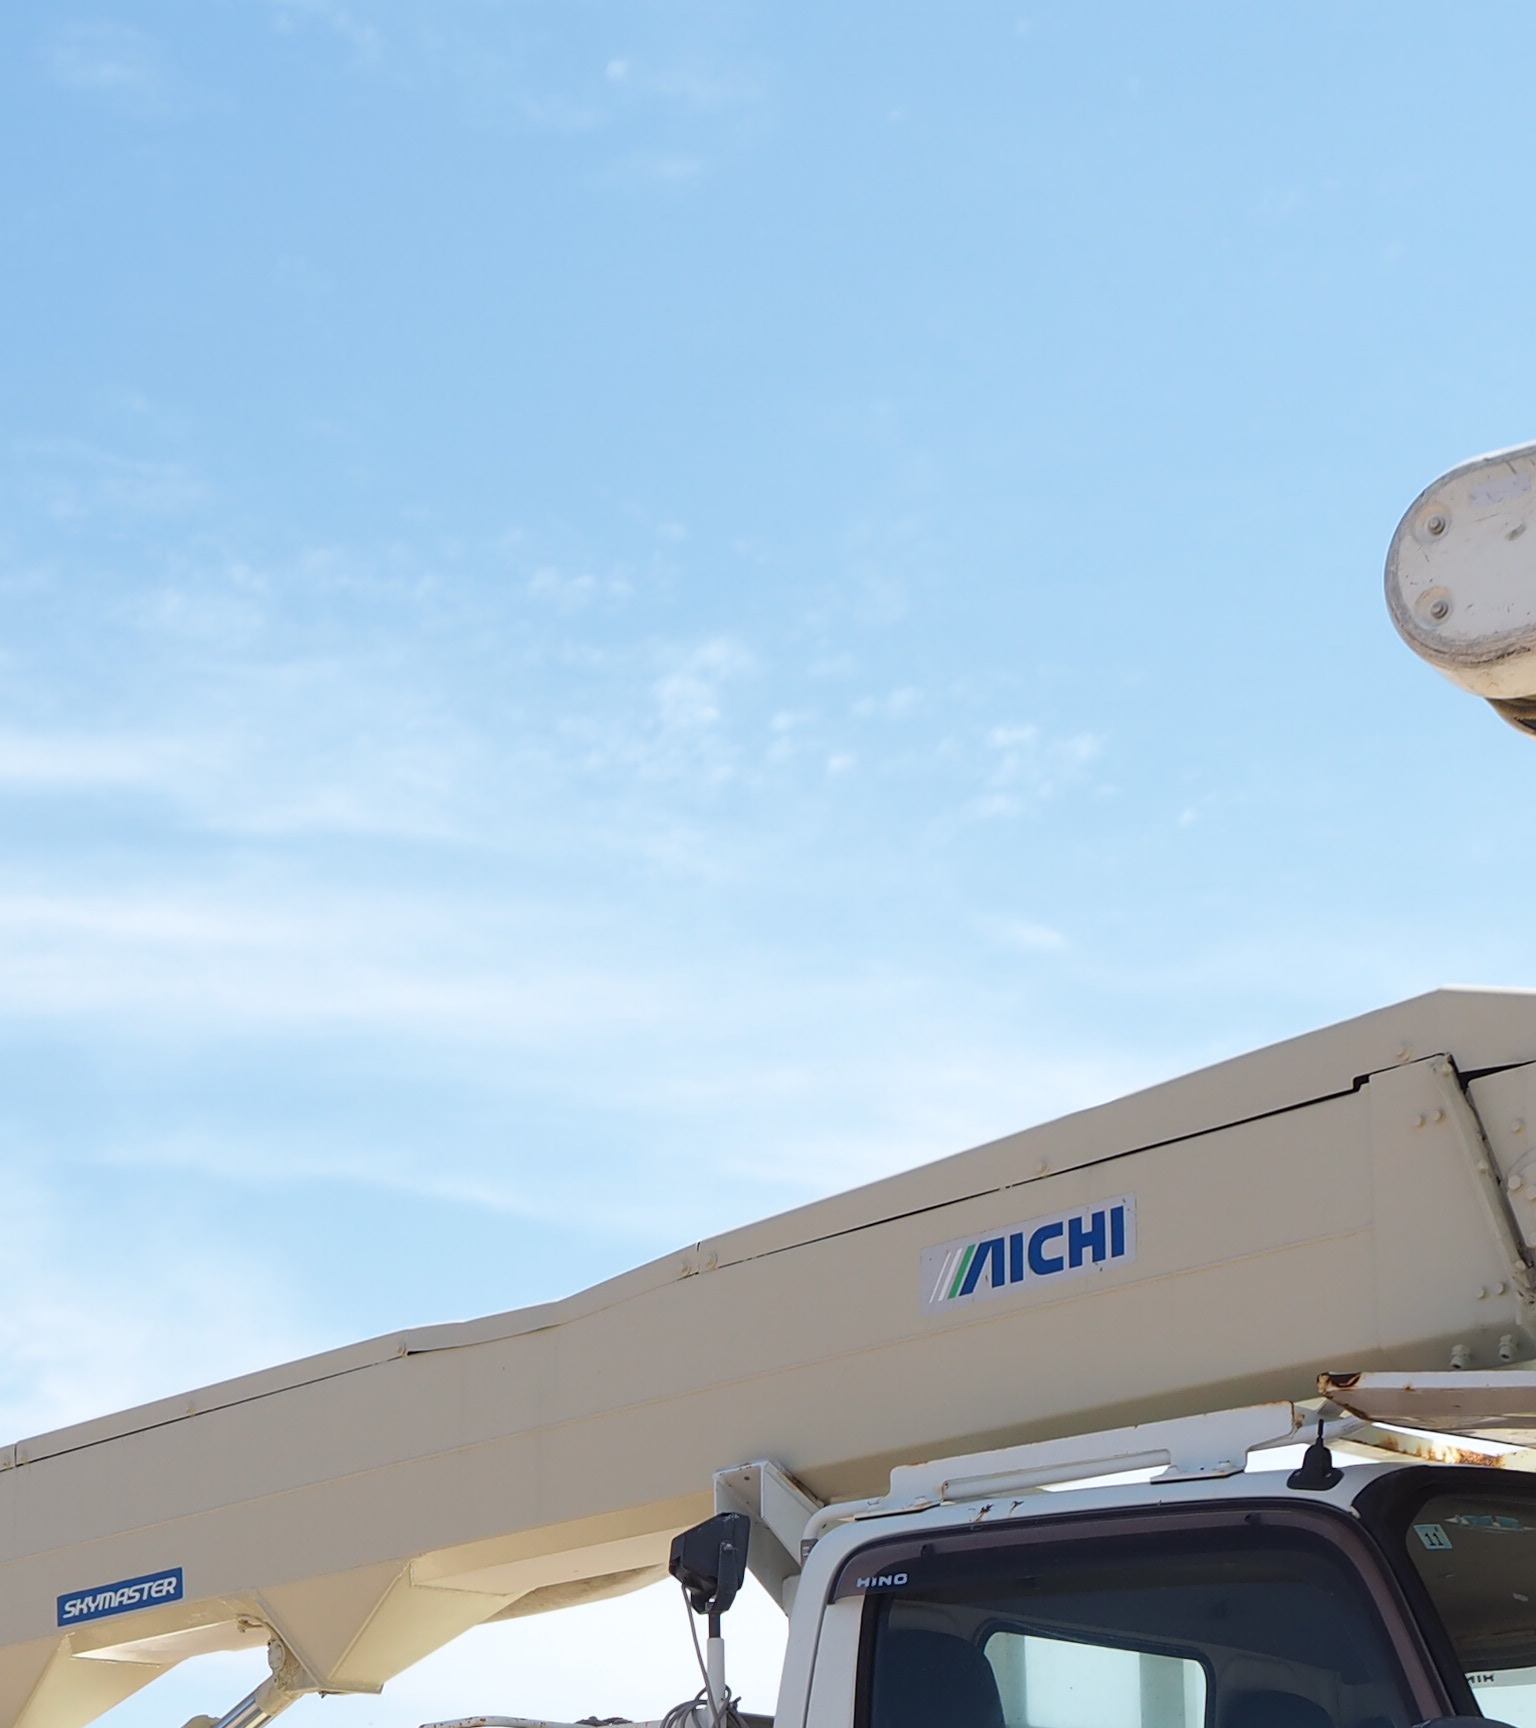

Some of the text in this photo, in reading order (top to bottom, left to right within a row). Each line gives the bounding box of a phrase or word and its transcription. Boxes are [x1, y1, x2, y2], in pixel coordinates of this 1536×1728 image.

[958, 1204, 1126, 1298] AICHI
[62, 1576, 178, 1619] SKYMASTER
[855, 1572, 909, 1589] HINO
